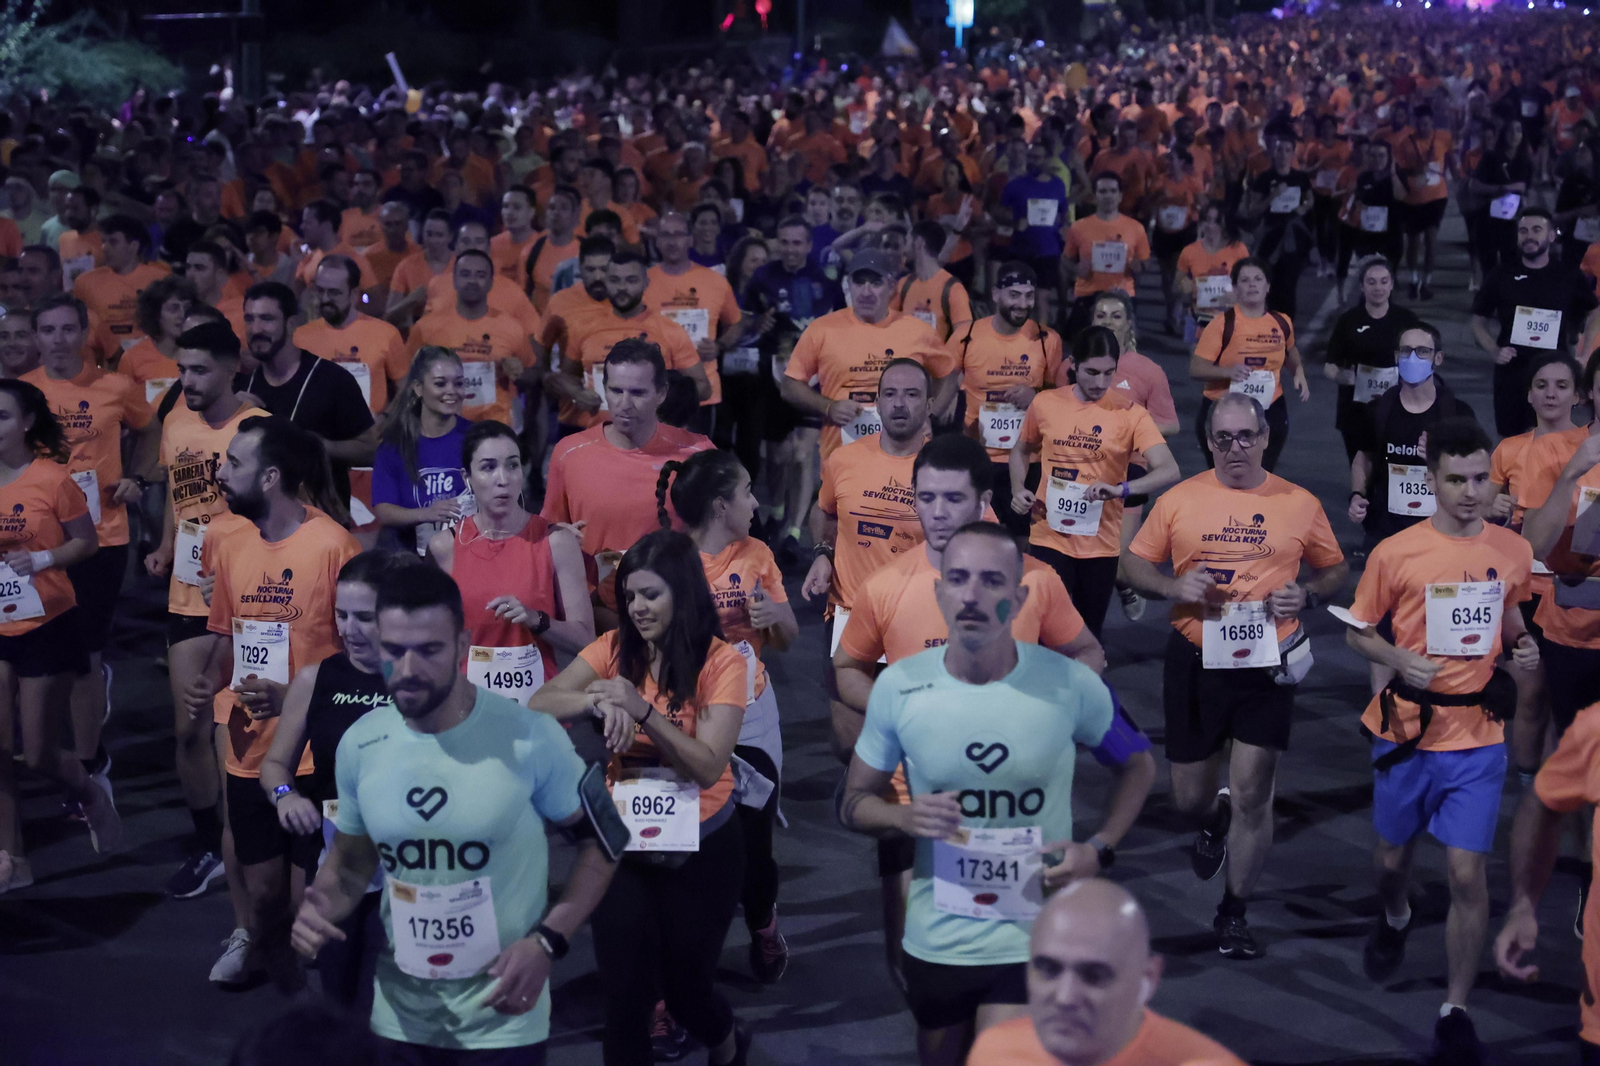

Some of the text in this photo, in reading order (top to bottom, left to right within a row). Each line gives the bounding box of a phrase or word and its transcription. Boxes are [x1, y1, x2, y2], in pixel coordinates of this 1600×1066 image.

[1527, 320, 1549, 333] 9350
[1243, 383, 1265, 394] 2944
[73, 421, 93, 429] KH7
[990, 418, 1022, 431] 20517
[1052, 439, 1101, 452] SEVILLA KH7
[1068, 435, 1103, 445] NOCTURNA
[1387, 442, 1418, 456] Deloi
[173, 463, 205, 484] CARRERA
[863, 490, 917, 508] SEVILLA KH
[1058, 497, 1088, 515] 9919
[4, 524, 26, 533] KH7
[1222, 526, 1267, 537] NOCTURNA
[1201, 533, 1266, 545] SEVILLA KH7
[257, 585, 294, 597] NOCTURNA
[711, 590, 747, 601] OCTURNA
[728, 598, 747, 608] KH7
[1451, 606, 1492, 625] 6345
[1219, 623, 1264, 641] 16589
[924, 638, 948, 649] SEV
[240, 644, 269, 665] 7292
[483, 669, 534, 689] 14993
[632, 796, 676, 816] 6962
[932, 787, 1046, 819] ano
[377, 838, 490, 873] sano
[956, 857, 1020, 882] 17341
[408, 915, 475, 941] 17356
